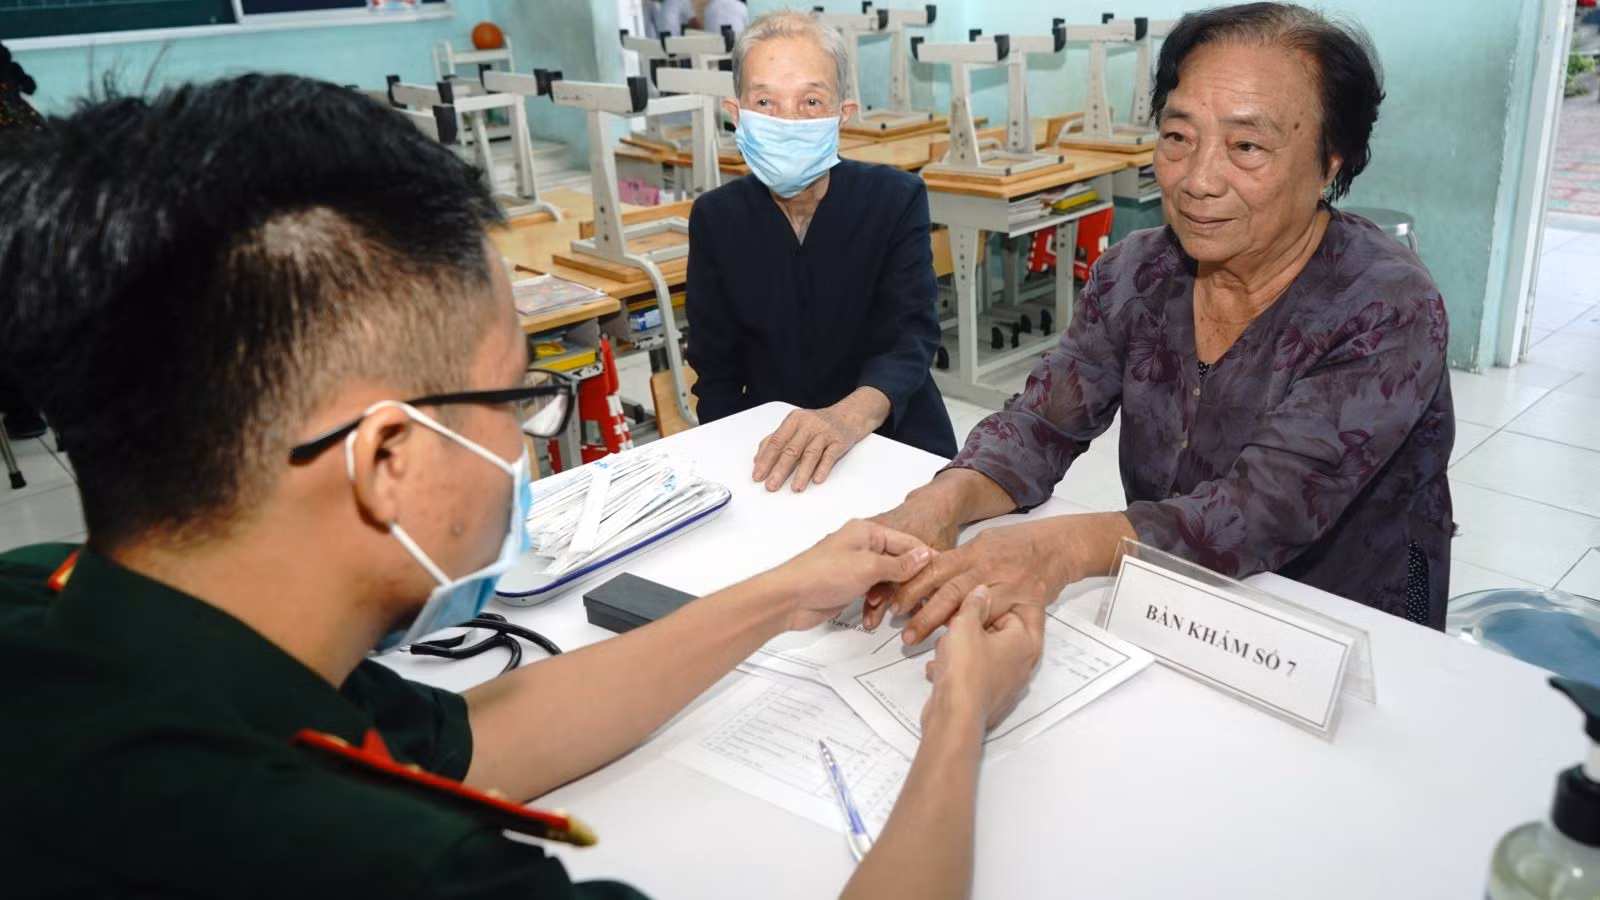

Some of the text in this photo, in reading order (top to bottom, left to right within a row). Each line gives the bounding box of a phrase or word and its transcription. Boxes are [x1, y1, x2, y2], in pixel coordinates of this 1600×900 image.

[1145, 605, 1184, 631] BÀN
[1188, 622, 1249, 658] KHÁM
[1286, 660, 1297, 677] 7
